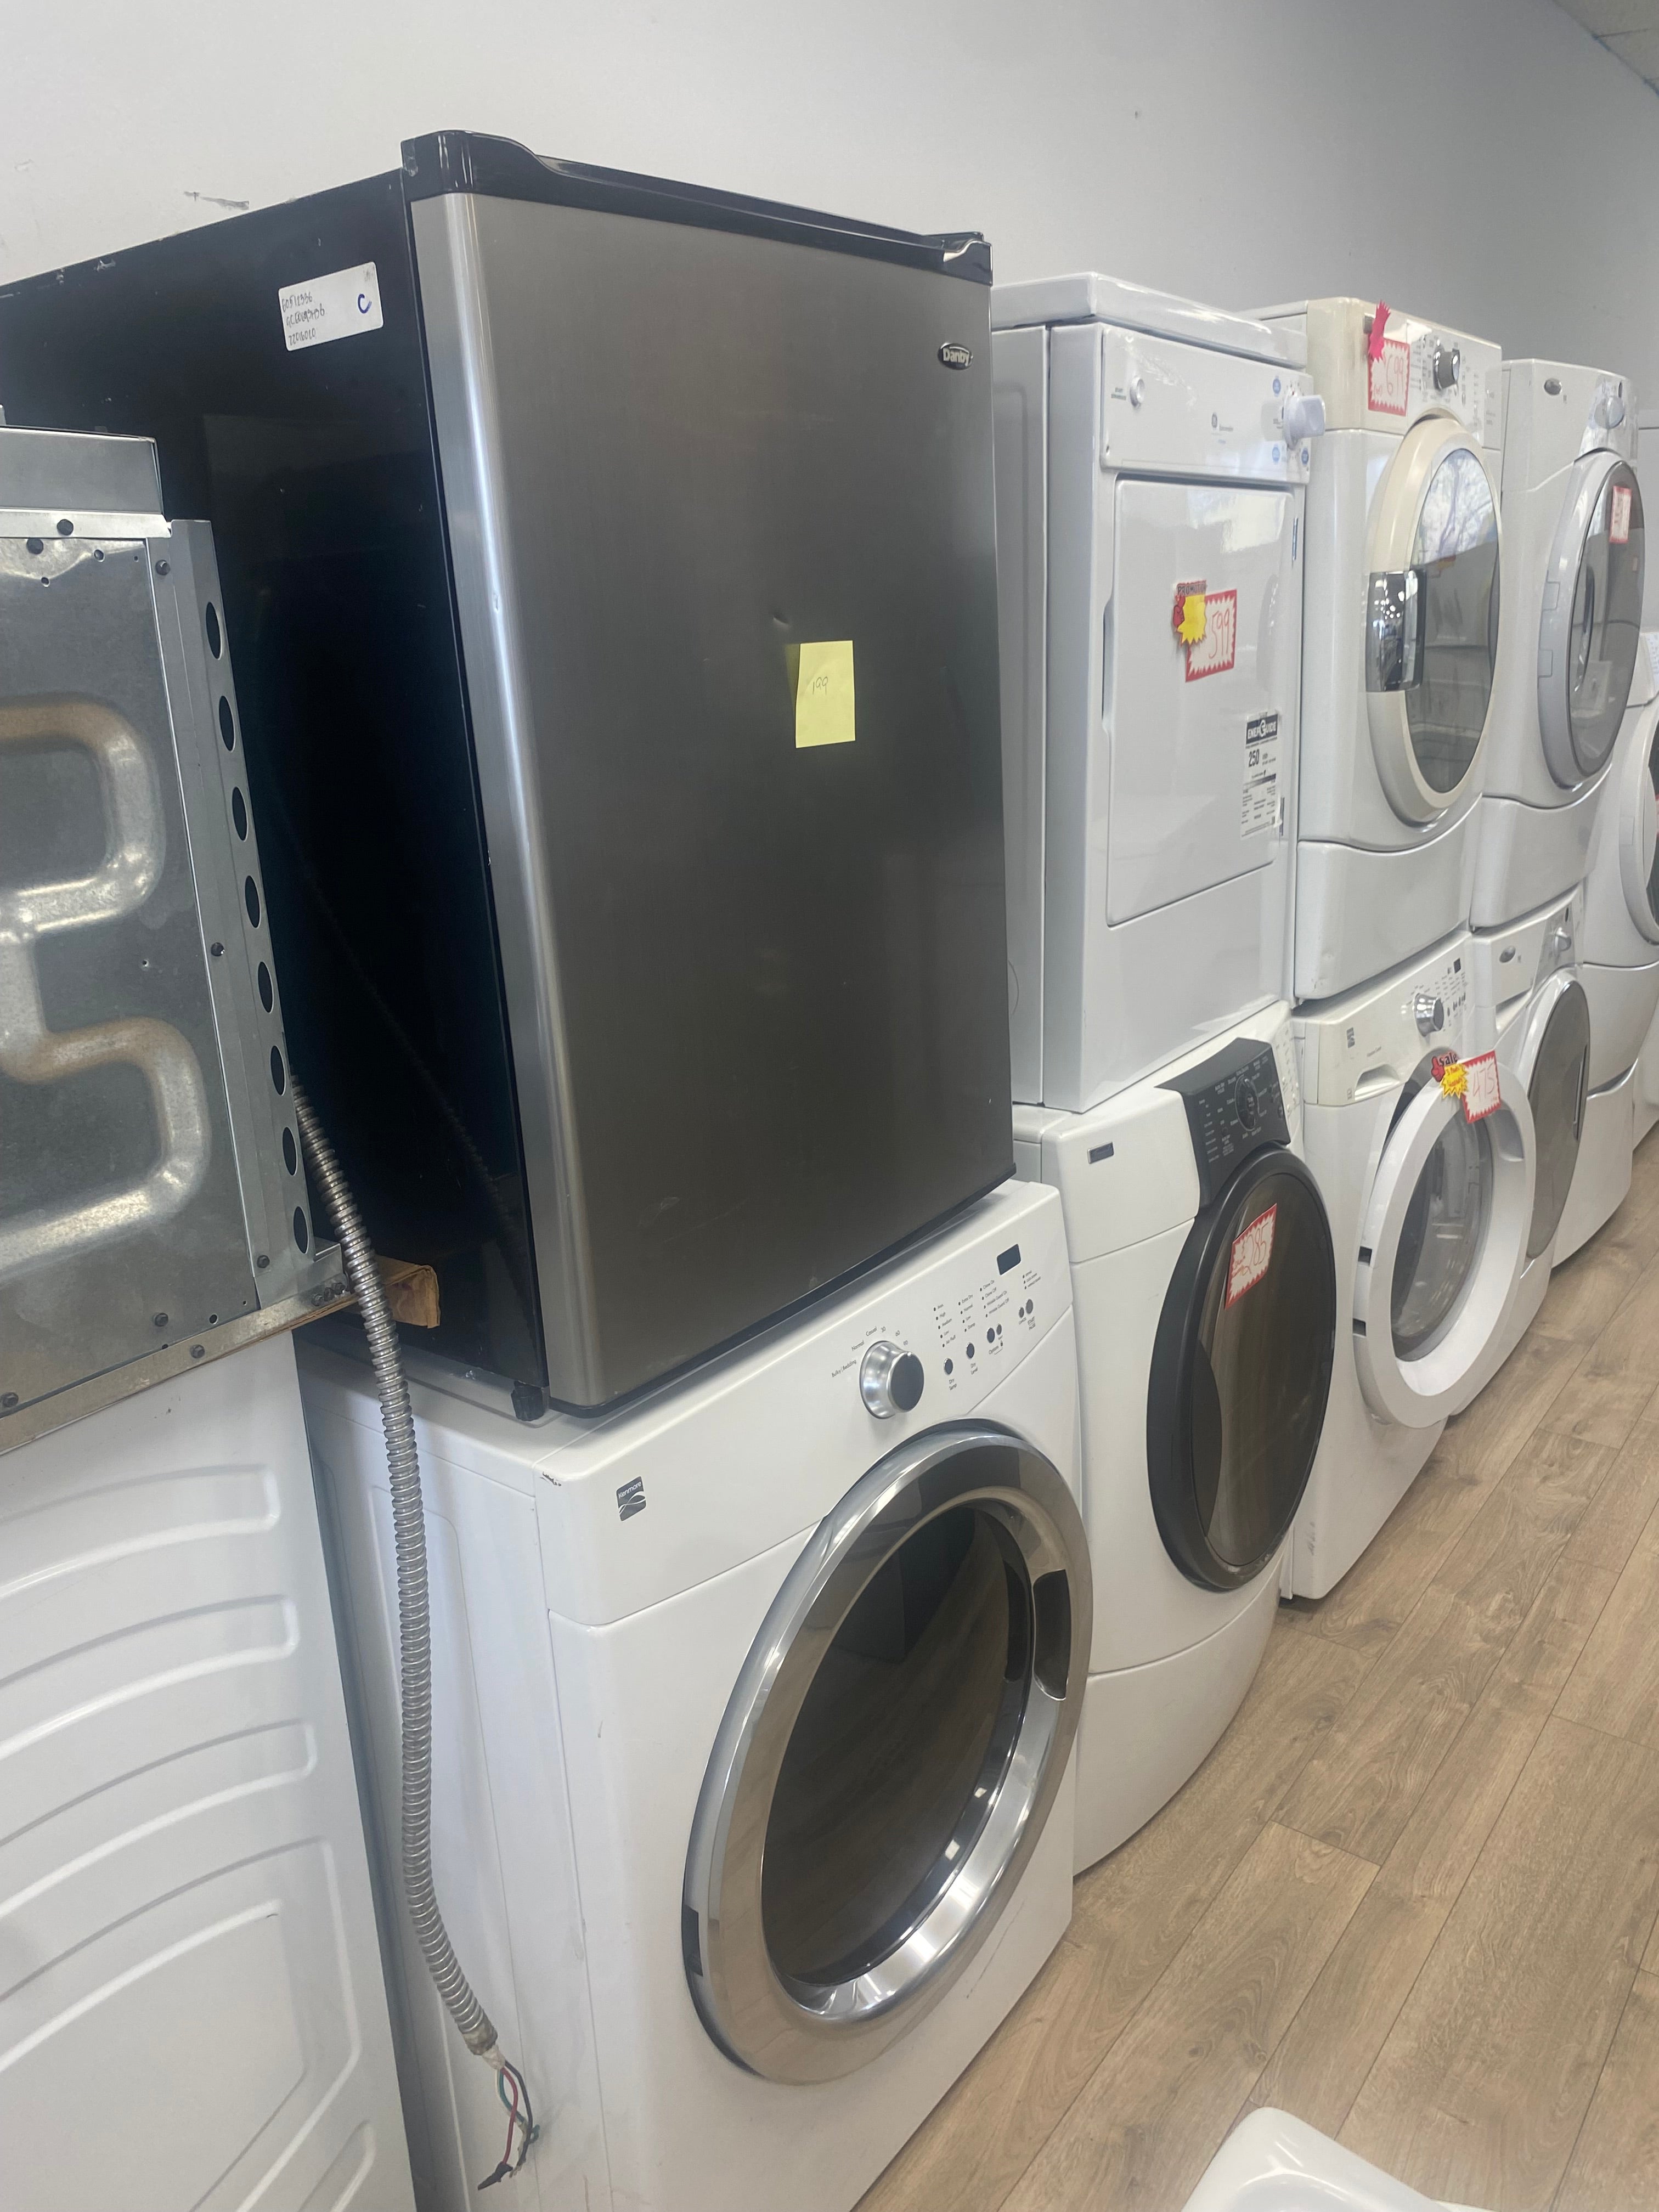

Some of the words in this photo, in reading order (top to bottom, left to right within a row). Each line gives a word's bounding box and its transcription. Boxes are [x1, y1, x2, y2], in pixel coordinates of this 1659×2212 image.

[358, 294, 372, 314] C
[943, 347, 969, 366] Danby
[812, 676, 828, 695] 199
[1249, 748, 1260, 768] 250
[866, 1326, 877, 1336] Casual
[851, 1340, 865, 1351] Normal
[618, 1481, 642, 1499] Kenmore
